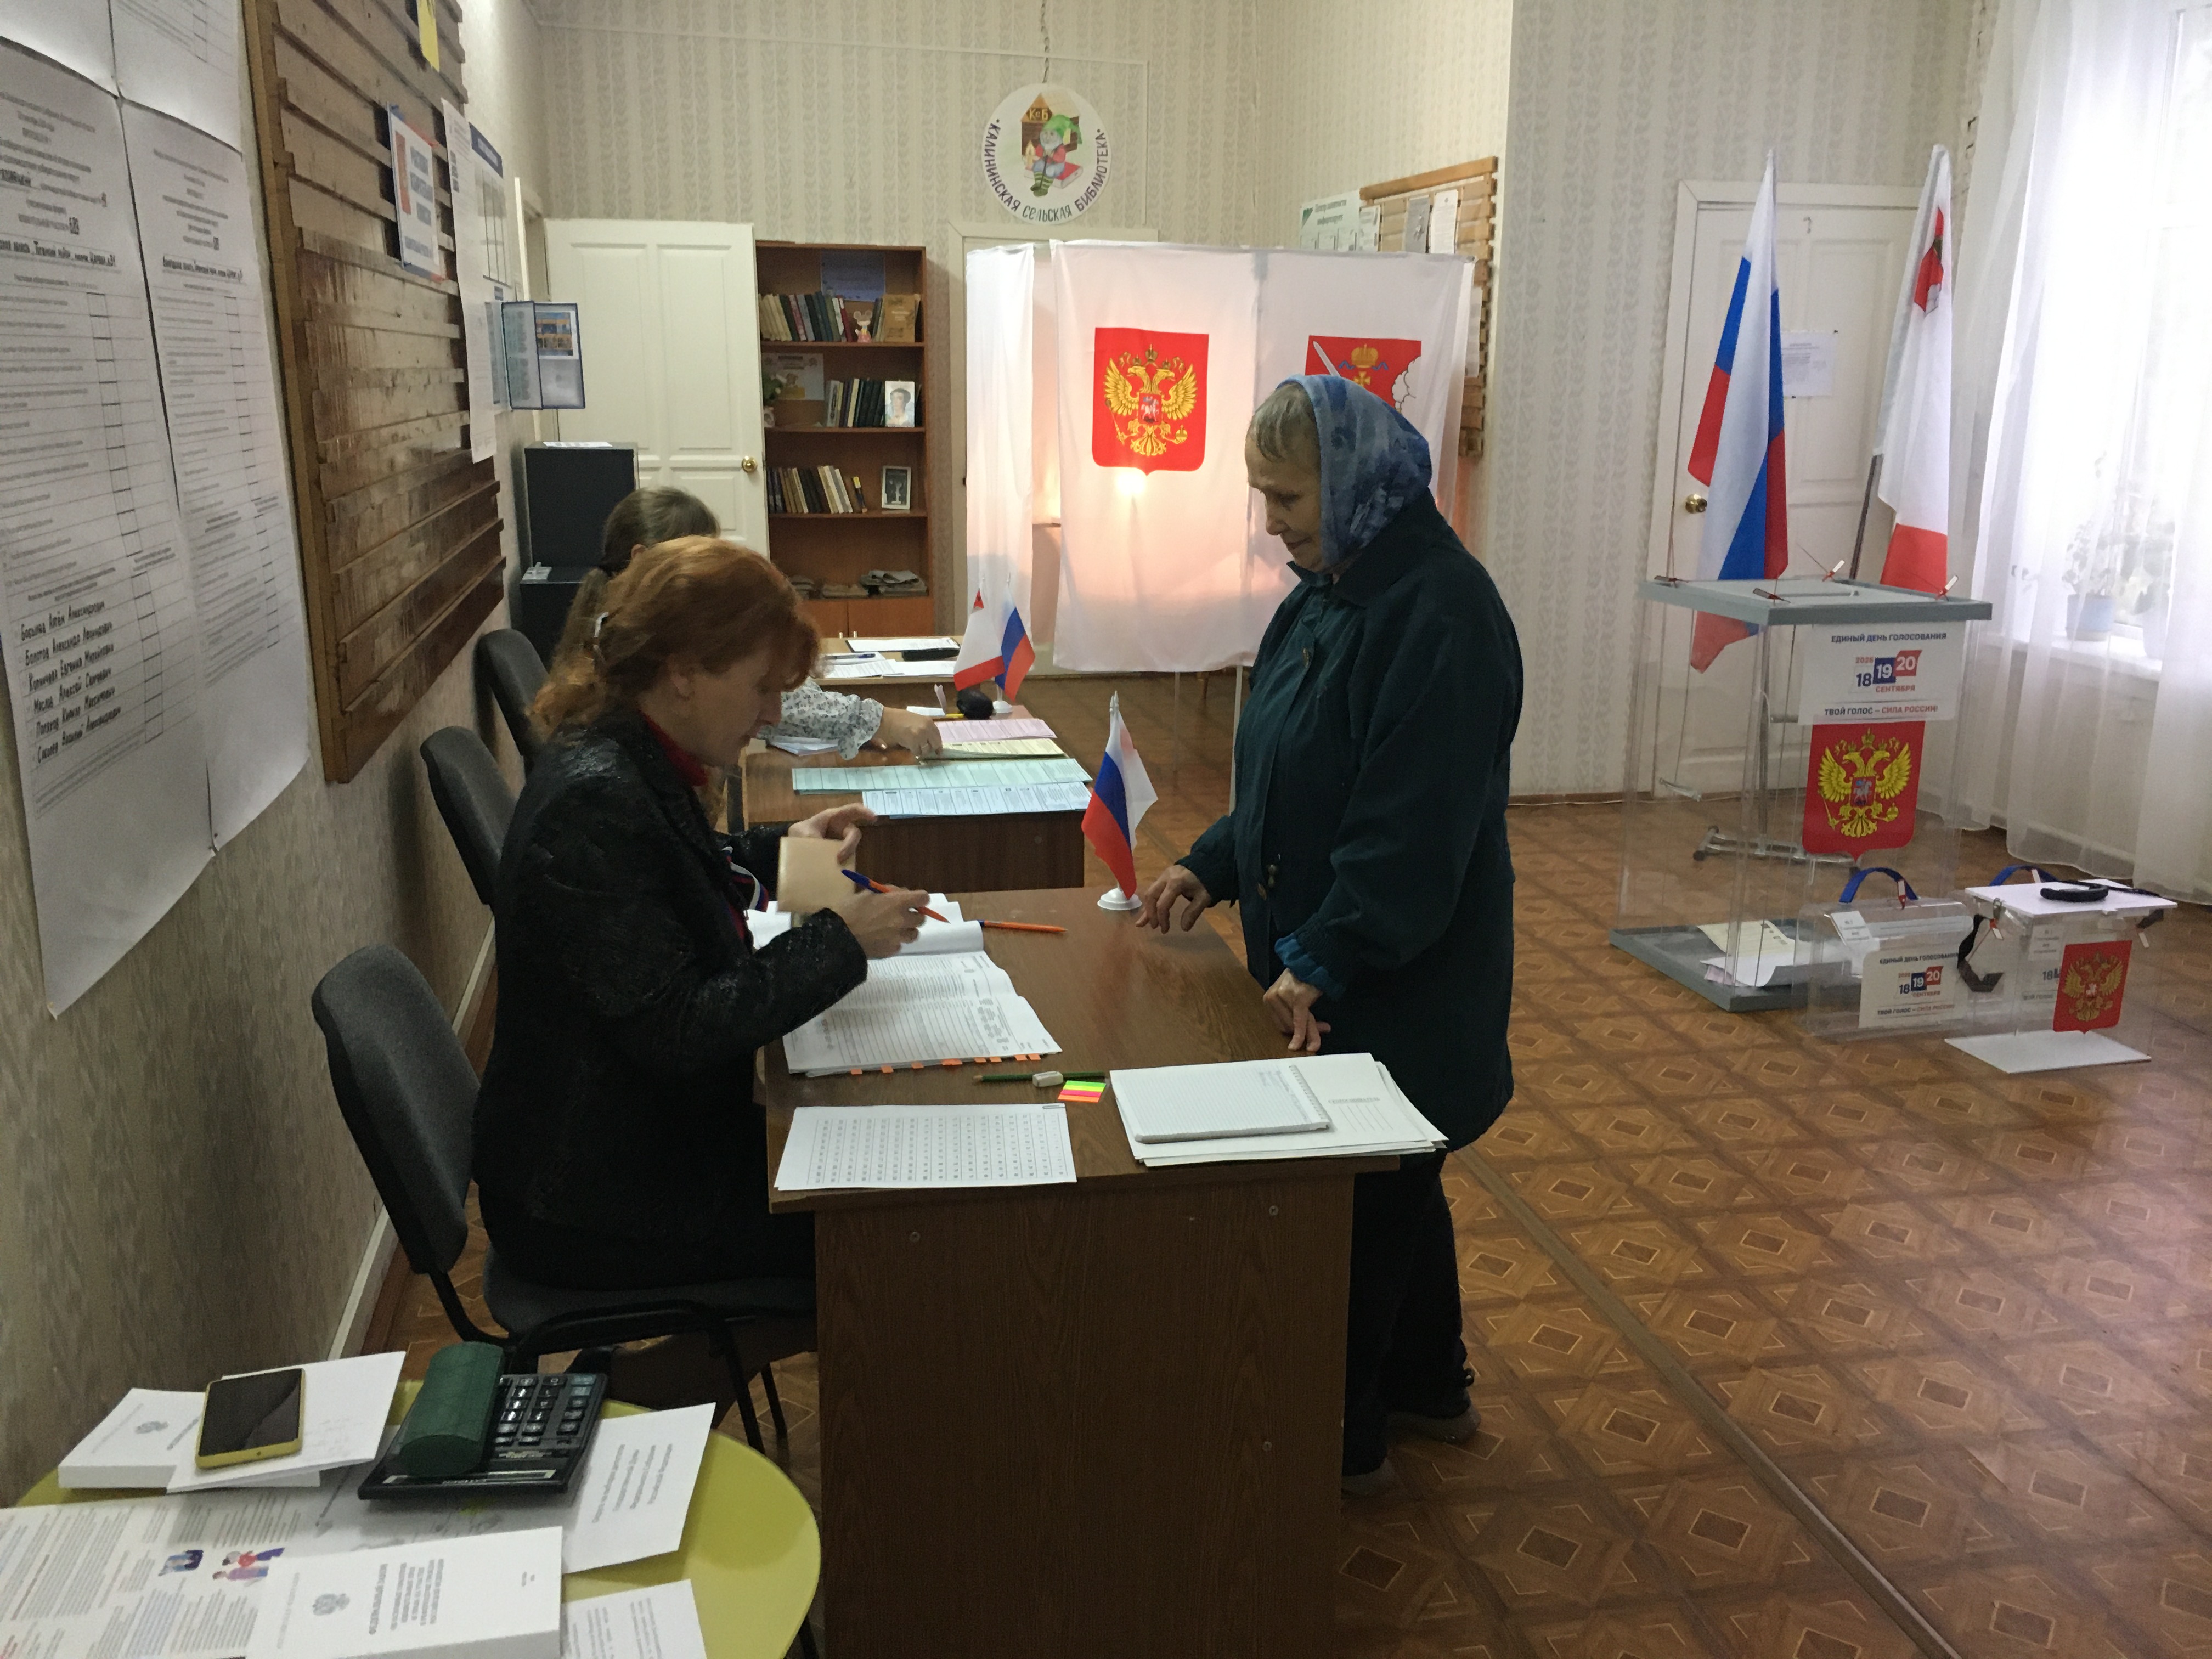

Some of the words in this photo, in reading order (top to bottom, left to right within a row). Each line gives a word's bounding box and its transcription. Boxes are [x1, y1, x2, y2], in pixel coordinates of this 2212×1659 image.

[984, 123, 1021, 212] КАЛИНИНСКАЯ
[1074, 133, 1108, 212] БИБЛИОТЕКА
[1831, 634, 1865, 643] ЕДИНЫЙ
[1889, 633, 1947, 641] ГОЛОСОВАНИЯ
[1856, 673, 1872, 687] 18
[1876, 664, 1892, 679] 19
[1896, 656, 1916, 671] 20
[1876, 685, 1915, 693] СЕНТЯБРЯ
[1825, 707, 1846, 715] ТВОЙ
[1879, 956, 1903, 964] ЕДИНЫЙ
[2042, 970, 2053, 981] 18
[1899, 984, 1910, 995] 18
[1912, 977, 1924, 988] 19
[1927, 971, 1940, 981] 20
